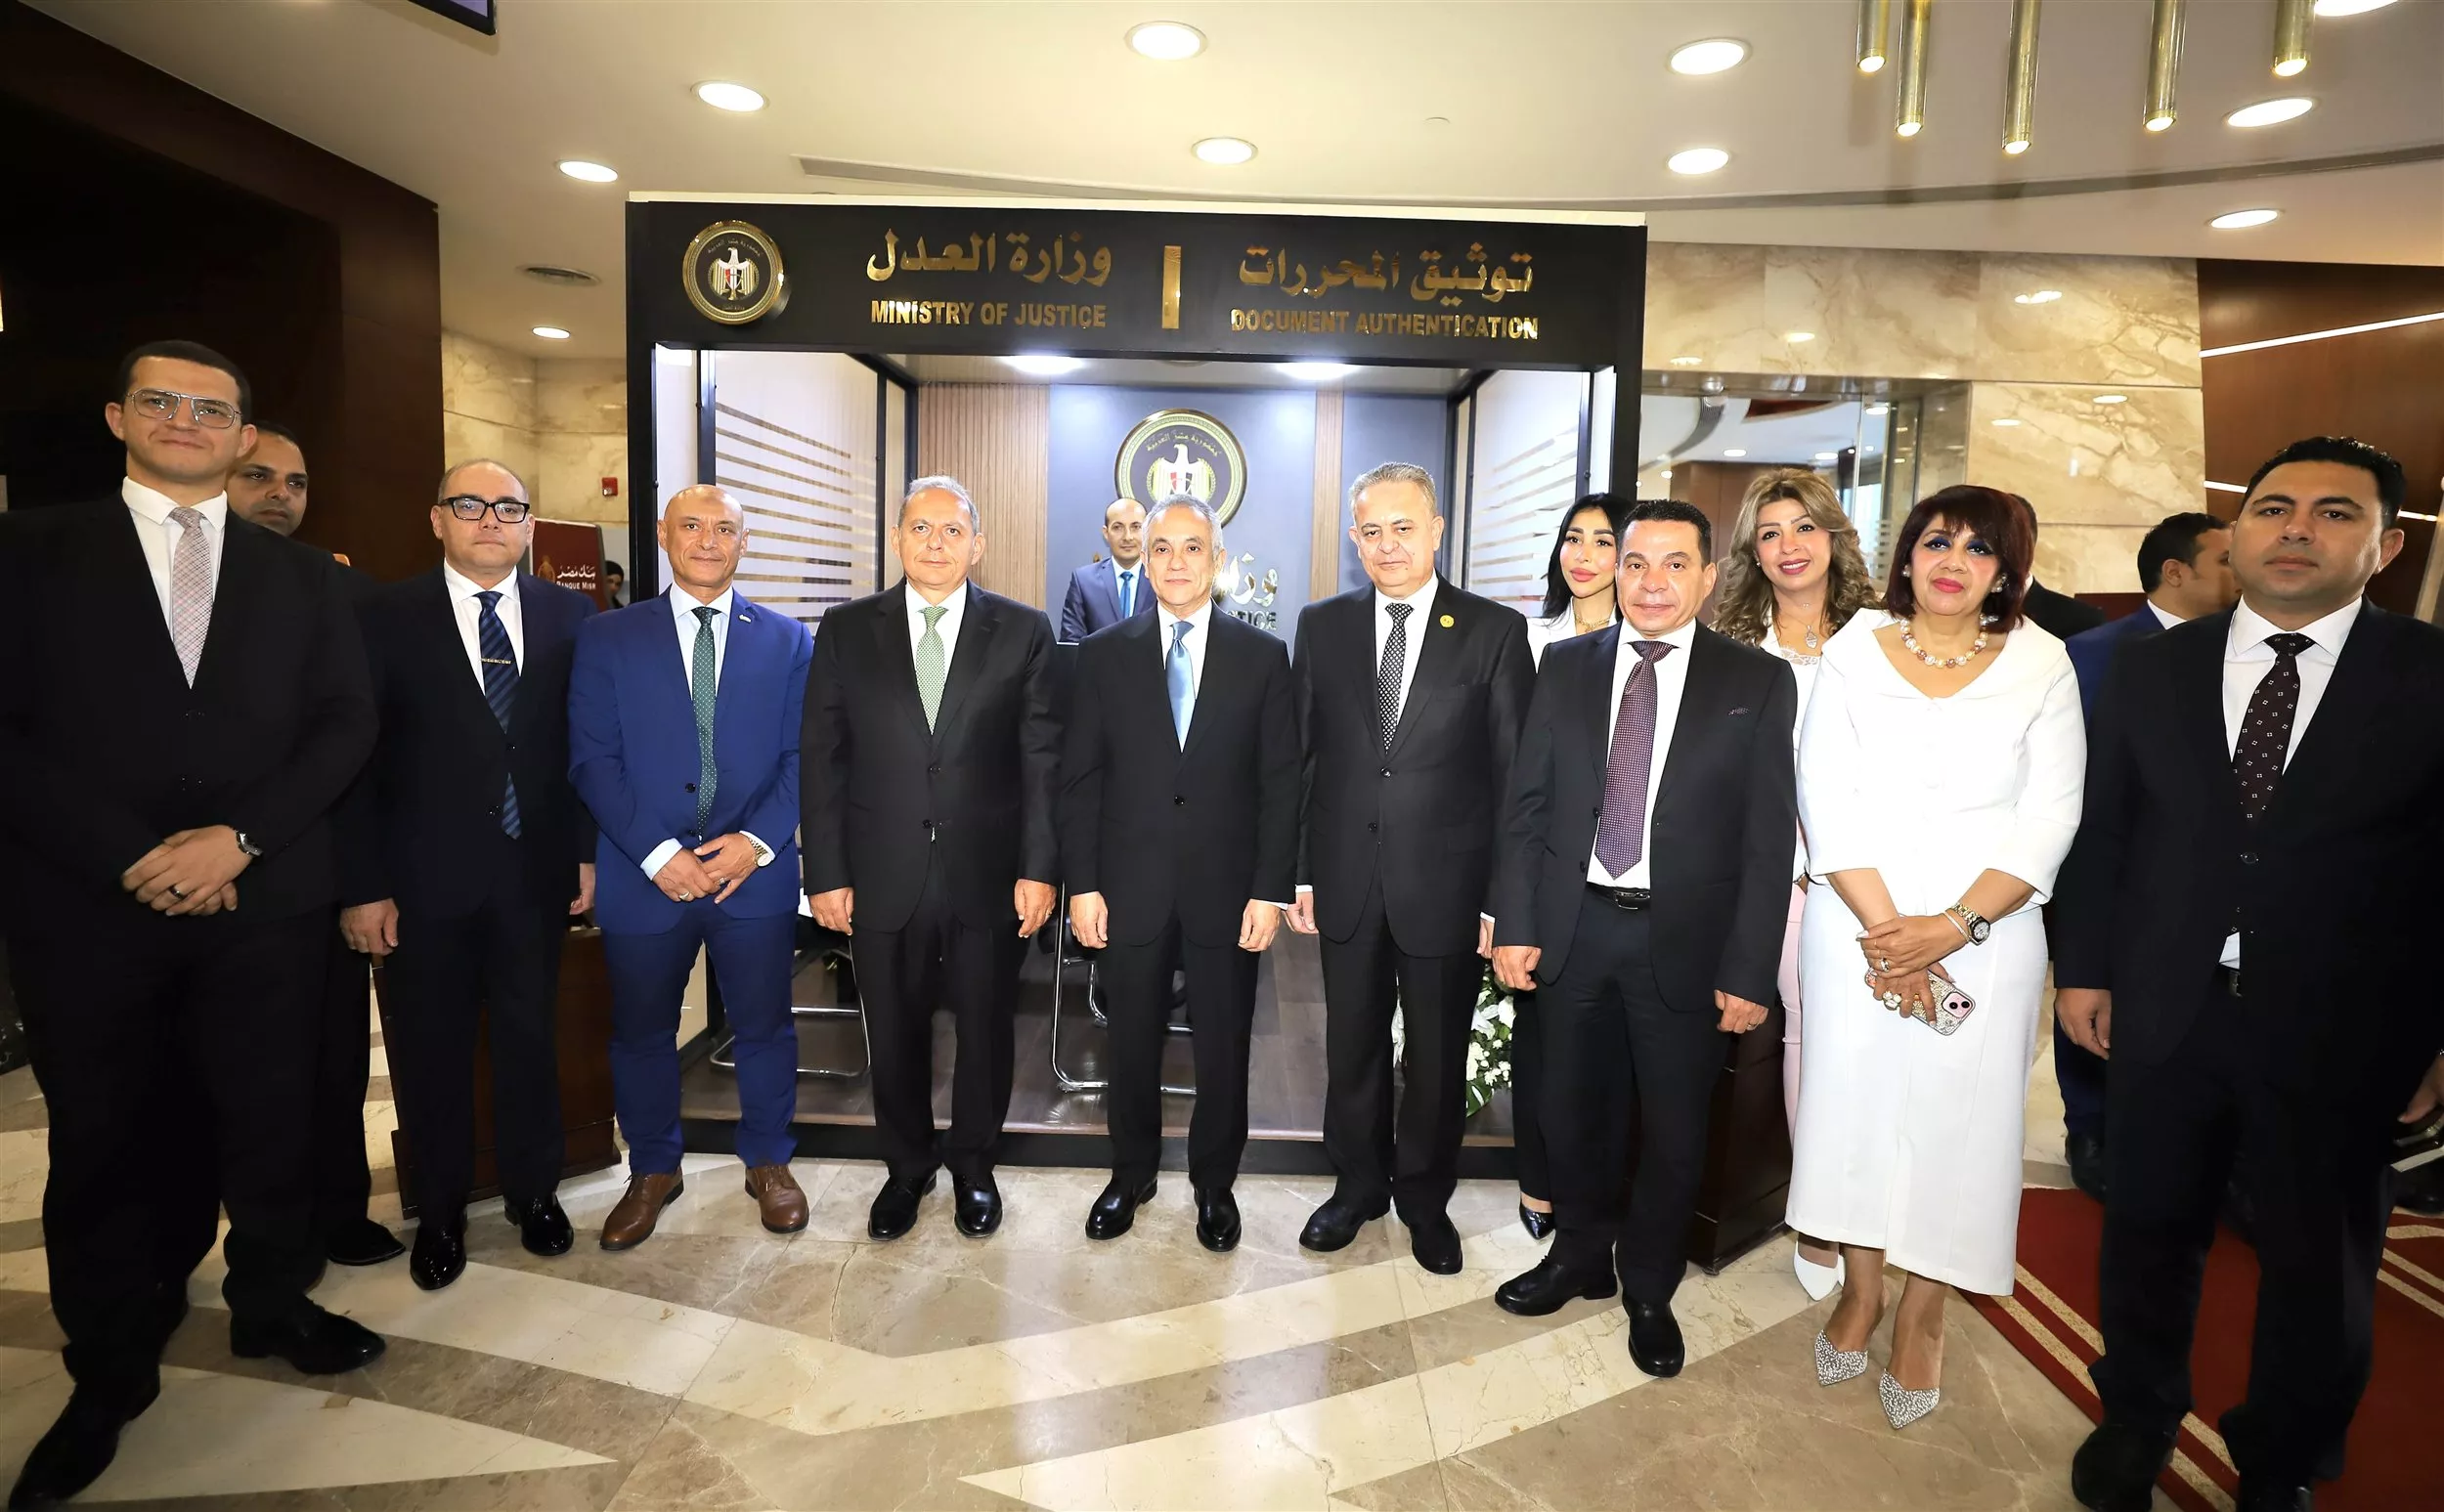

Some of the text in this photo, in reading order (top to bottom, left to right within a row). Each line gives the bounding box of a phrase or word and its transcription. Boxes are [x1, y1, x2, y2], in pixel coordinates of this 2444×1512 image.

[866, 228, 1113, 287] وزارة العدل
[1239, 242, 1534, 307] توثيق المحررات
[871, 300, 1107, 328] MINISTRY OF JUSTICE
[1231, 308, 1539, 340] DOCUMENT AUTHENTICATION
